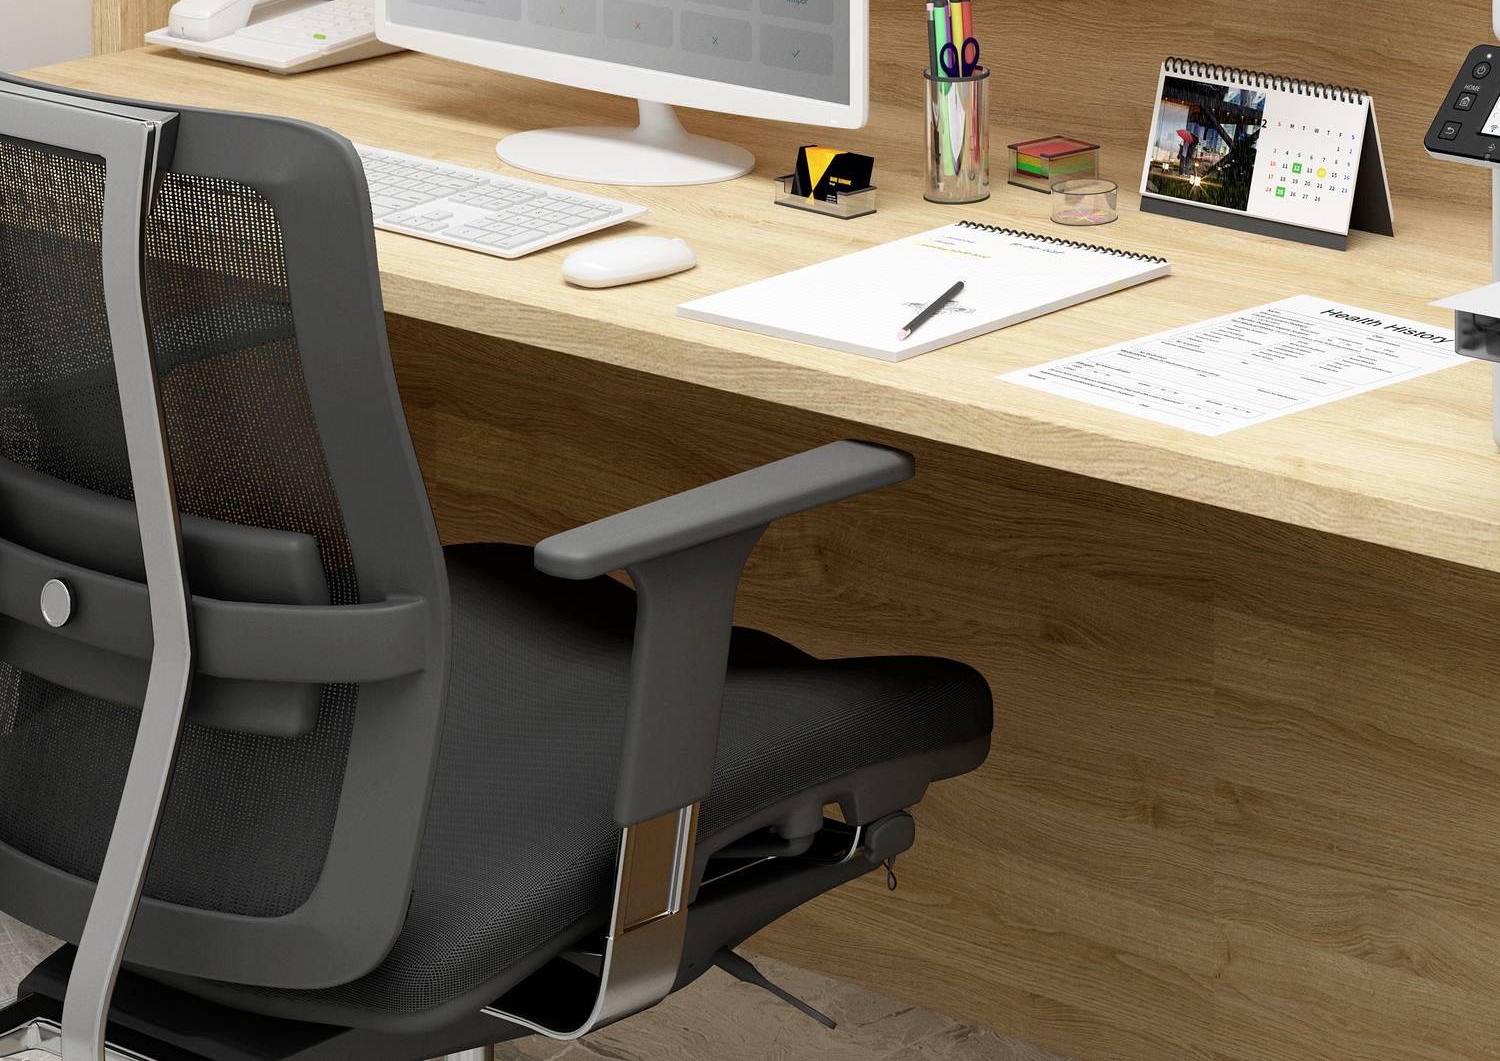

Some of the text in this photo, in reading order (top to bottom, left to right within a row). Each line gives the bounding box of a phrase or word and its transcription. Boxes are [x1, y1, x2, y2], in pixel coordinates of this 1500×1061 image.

[1464, 84, 1481, 92] HOME
[1261, 119, 1268, 128] 2
[1320, 308, 1454, 344] Health History
